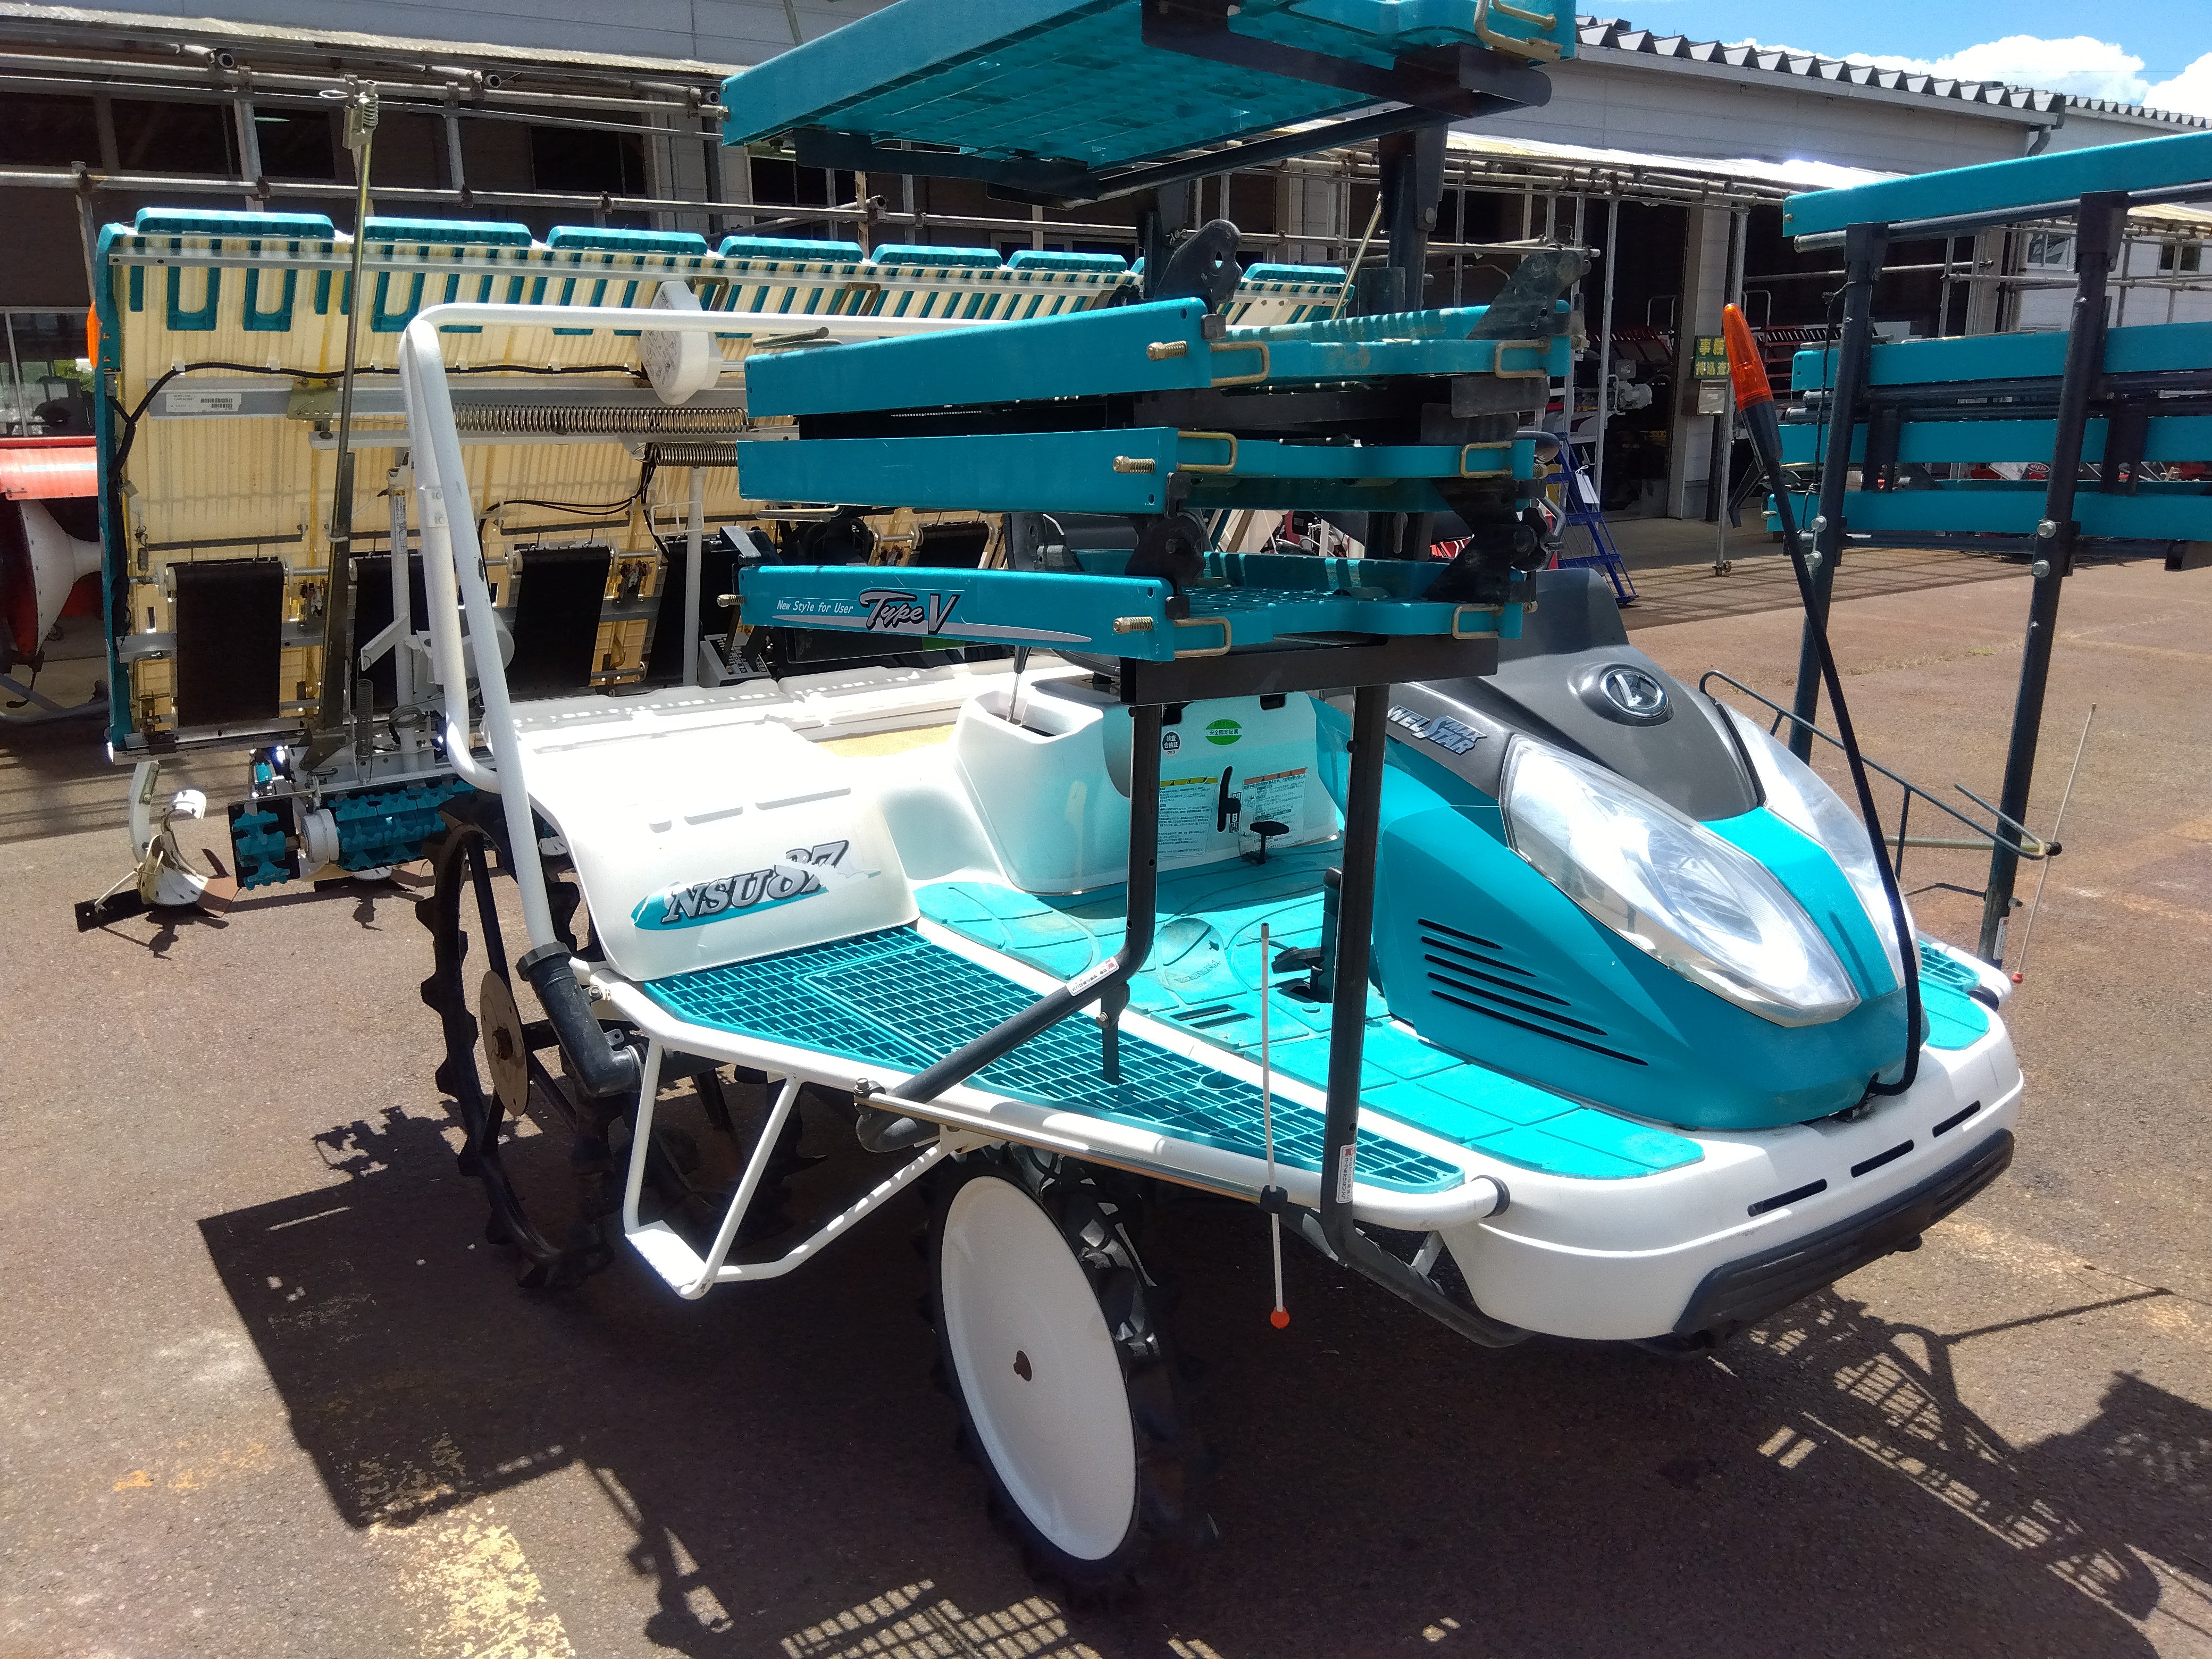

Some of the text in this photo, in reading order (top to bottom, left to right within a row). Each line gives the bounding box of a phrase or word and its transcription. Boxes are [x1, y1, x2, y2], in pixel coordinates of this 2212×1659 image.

[776, 590, 962, 635] New Style for User Type V
